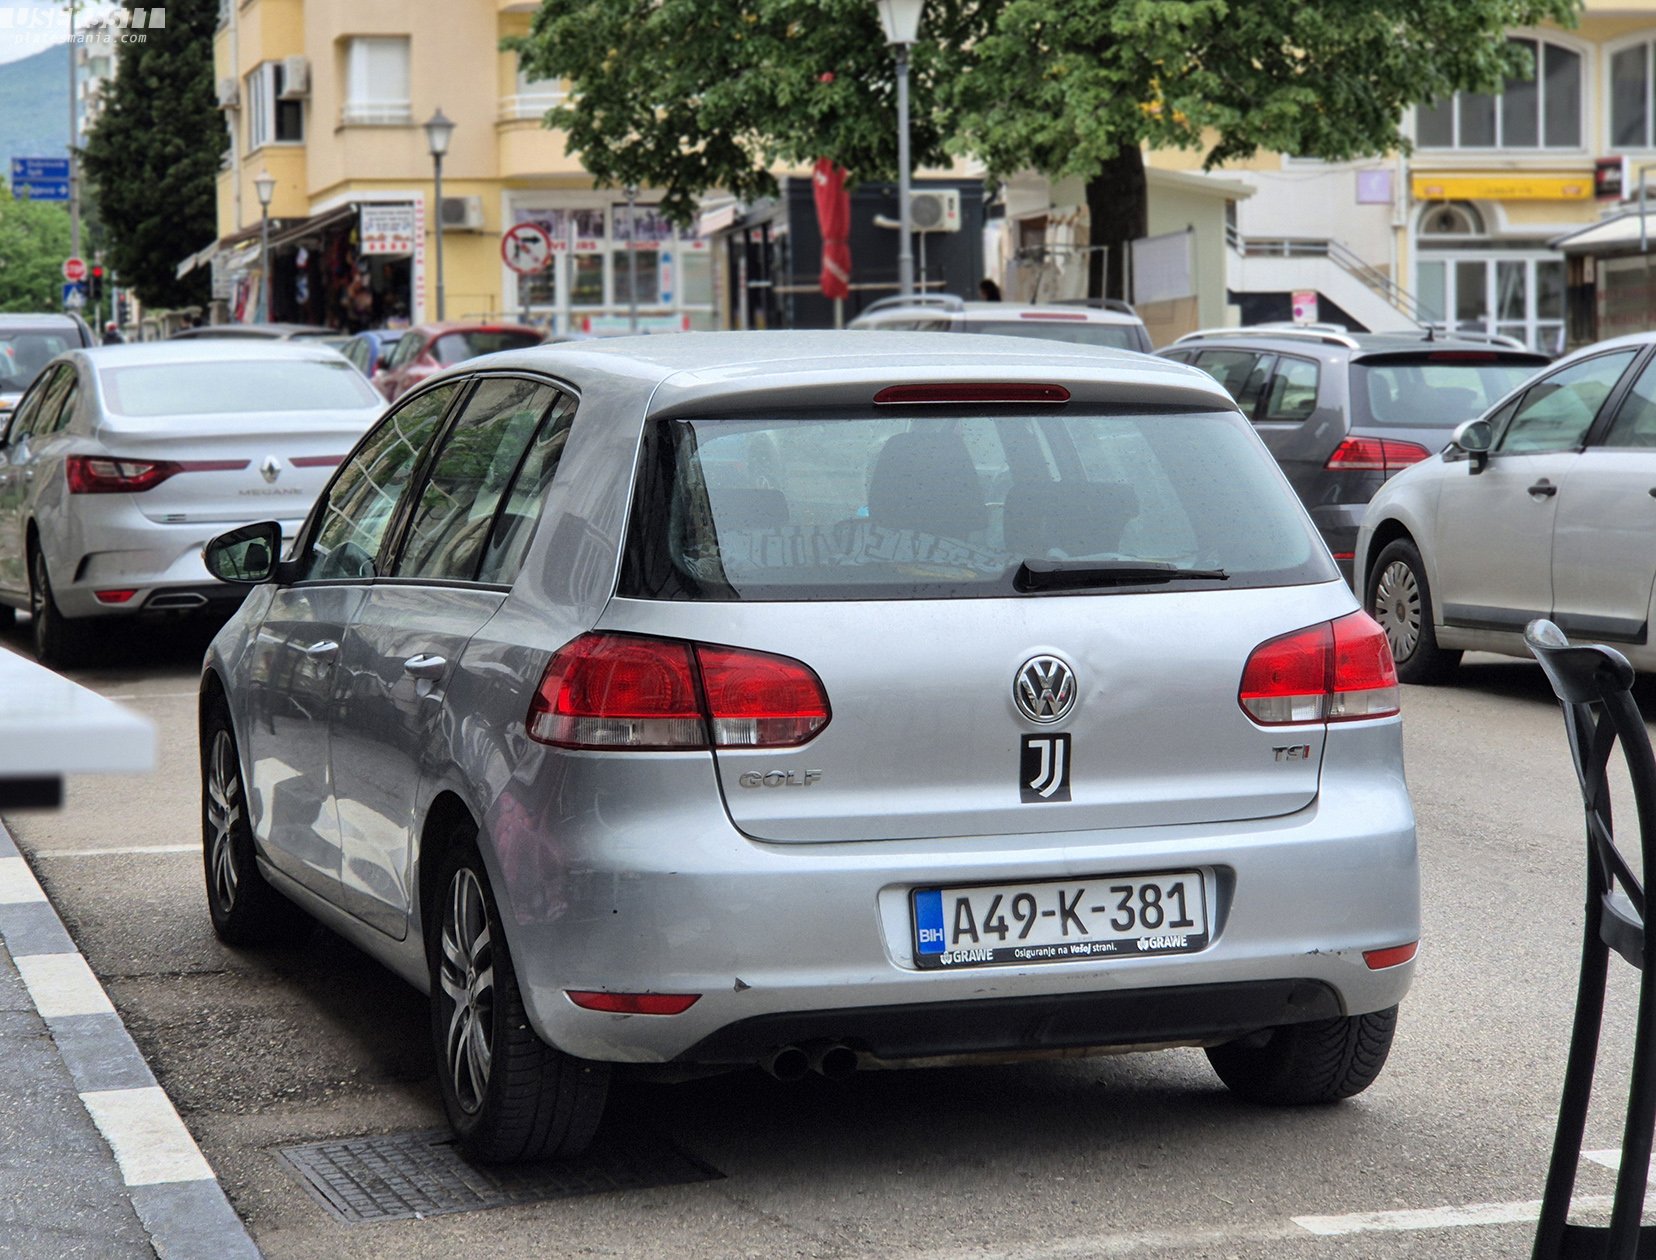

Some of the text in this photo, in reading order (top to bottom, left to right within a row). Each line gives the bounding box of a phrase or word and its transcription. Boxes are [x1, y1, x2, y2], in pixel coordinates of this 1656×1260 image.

[739, 769, 822, 788] GOLF
[952, 881, 1194, 945] A49-K-381
[919, 928, 943, 943] BIH
[1149, 935, 1188, 949] GRAWE
[953, 948, 993, 963] GRAWE
[1014, 946, 1056, 959] Osiguranje
[1057, 947, 1068, 955] na
